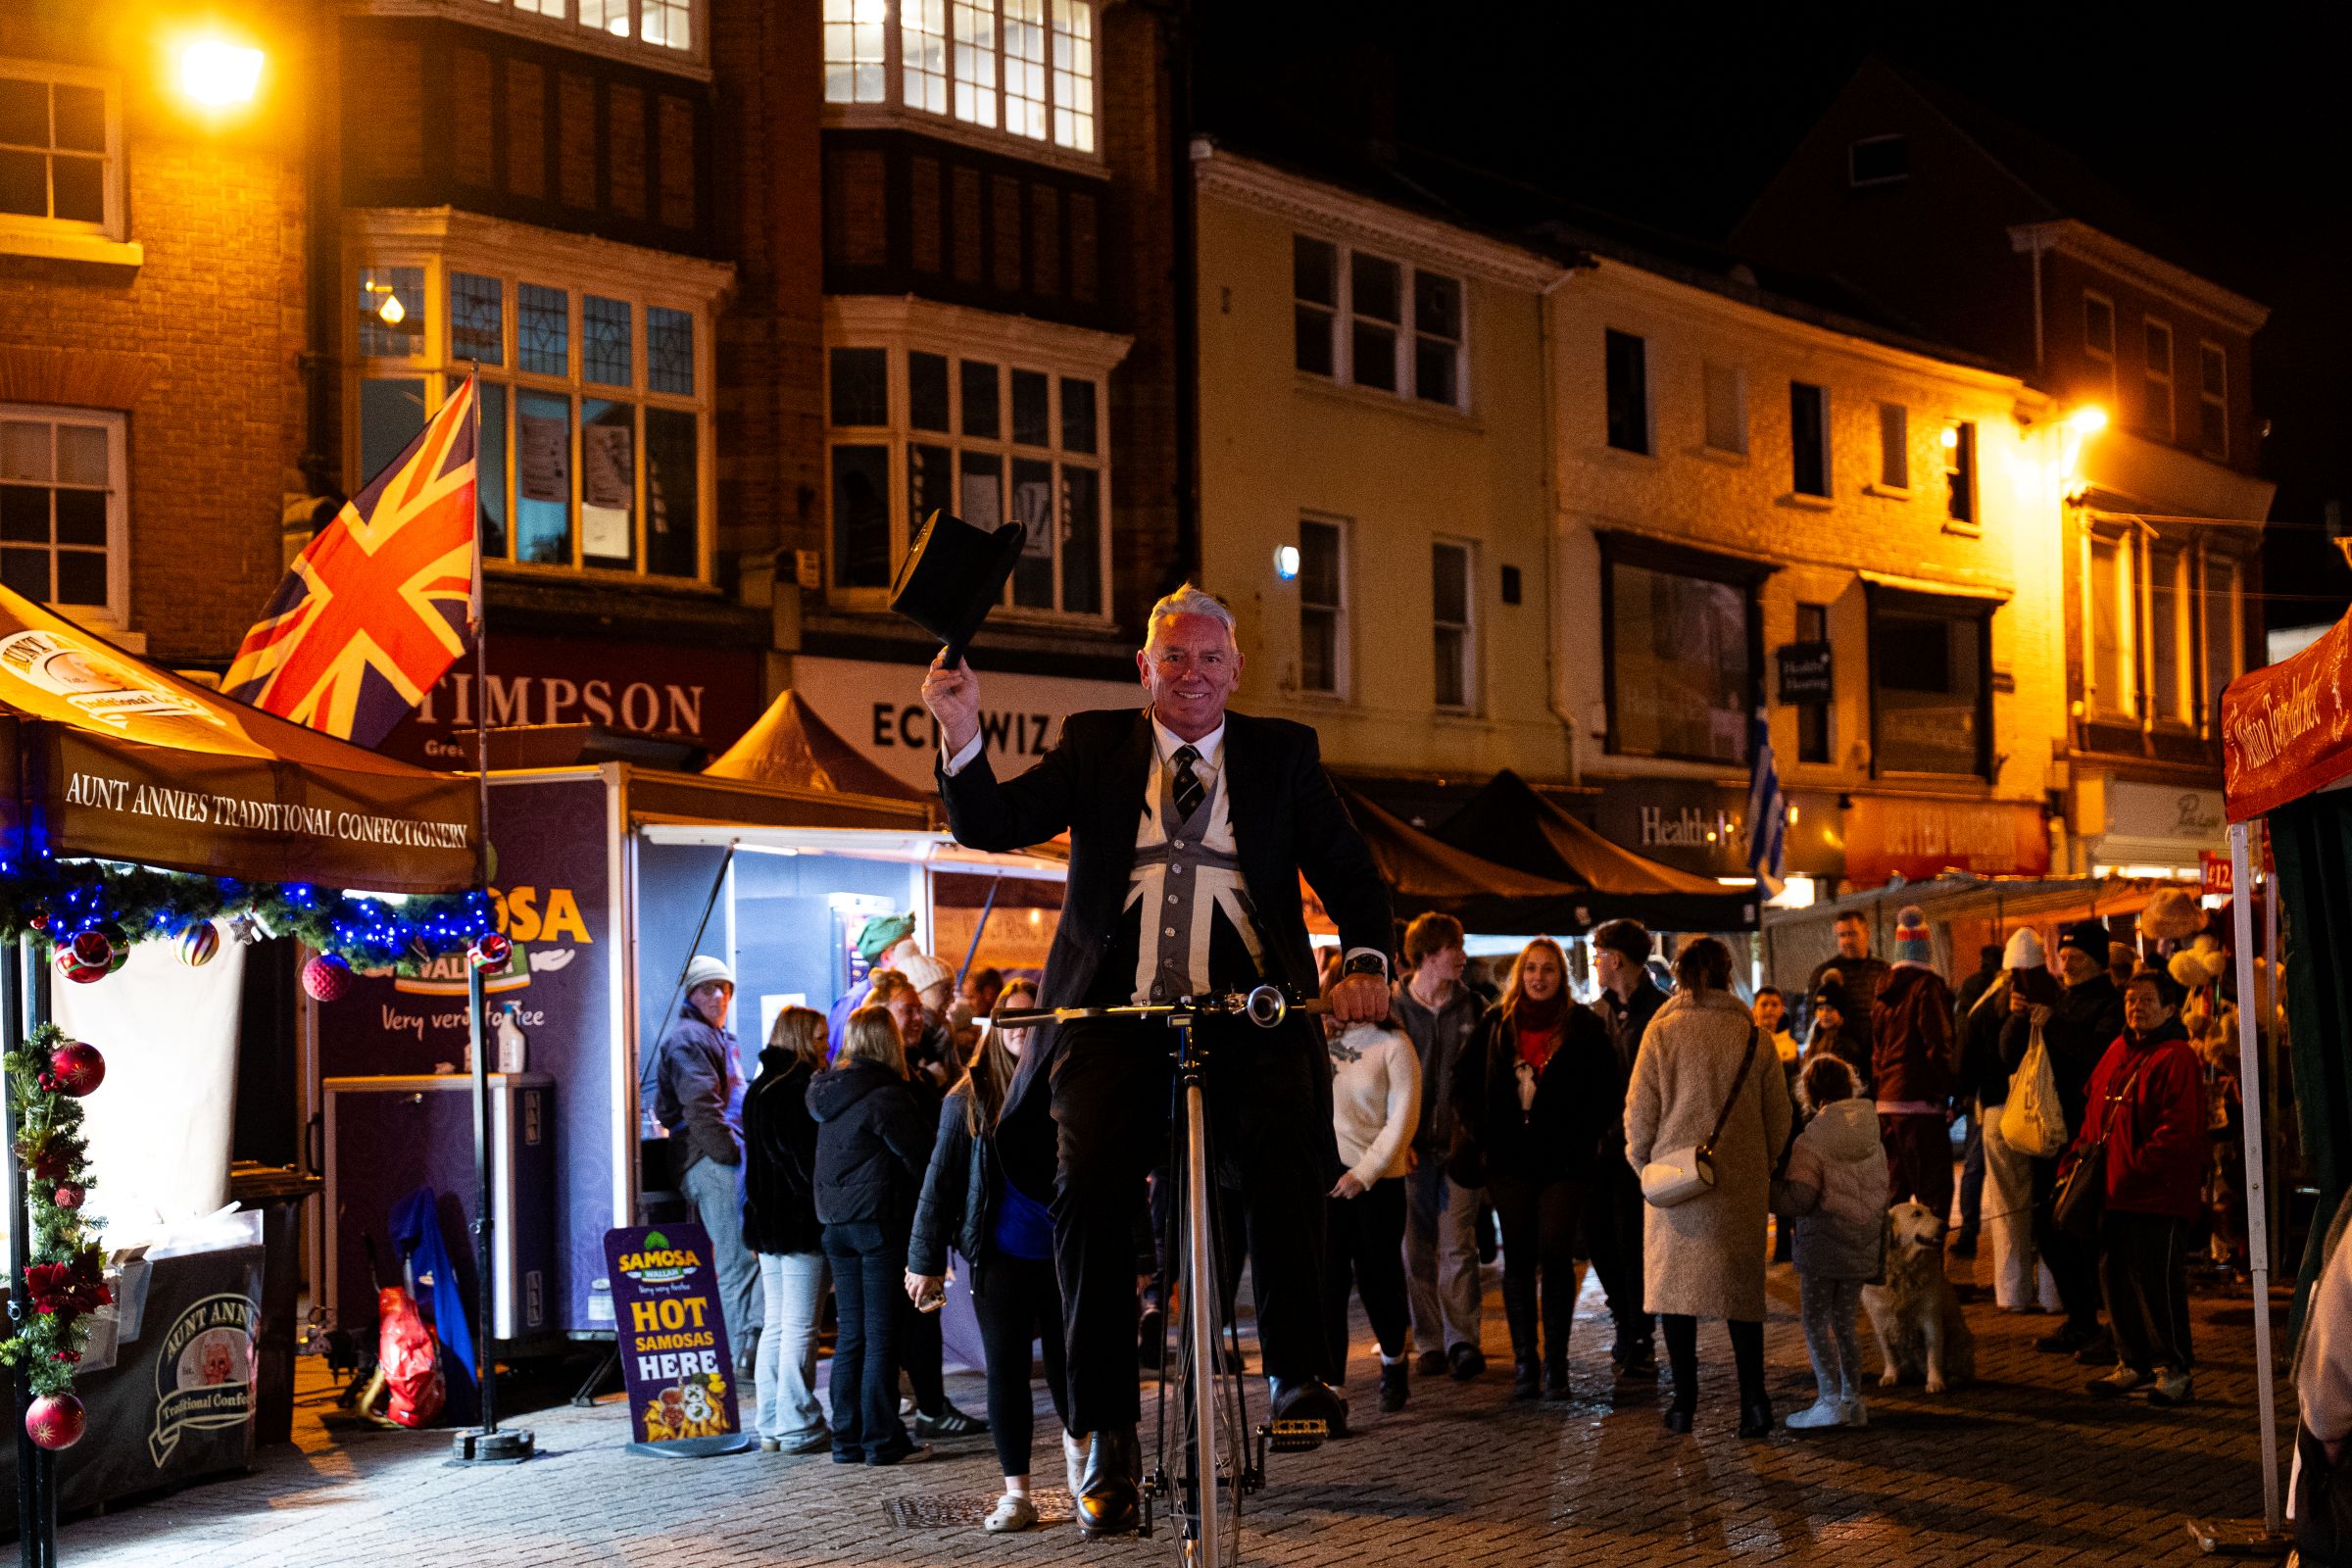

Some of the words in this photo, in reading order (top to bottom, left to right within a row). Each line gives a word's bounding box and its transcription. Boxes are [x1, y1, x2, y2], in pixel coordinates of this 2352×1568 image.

[416, 672, 705, 735] TIMPSON
[66, 771, 129, 811] AUNT
[131, 783, 209, 823] ANNIES
[212, 796, 335, 838] TRADITIONAL
[337, 810, 468, 849] CONFECTIONERY
[382, 1002, 424, 1042] Very
[618, 1249, 702, 1272] SAMOSA
[629, 1297, 709, 1333] HOT
[166, 1305, 208, 1364] AUNT
[635, 1331, 715, 1352] SAMOSAS
[637, 1349, 719, 1381] HERE
